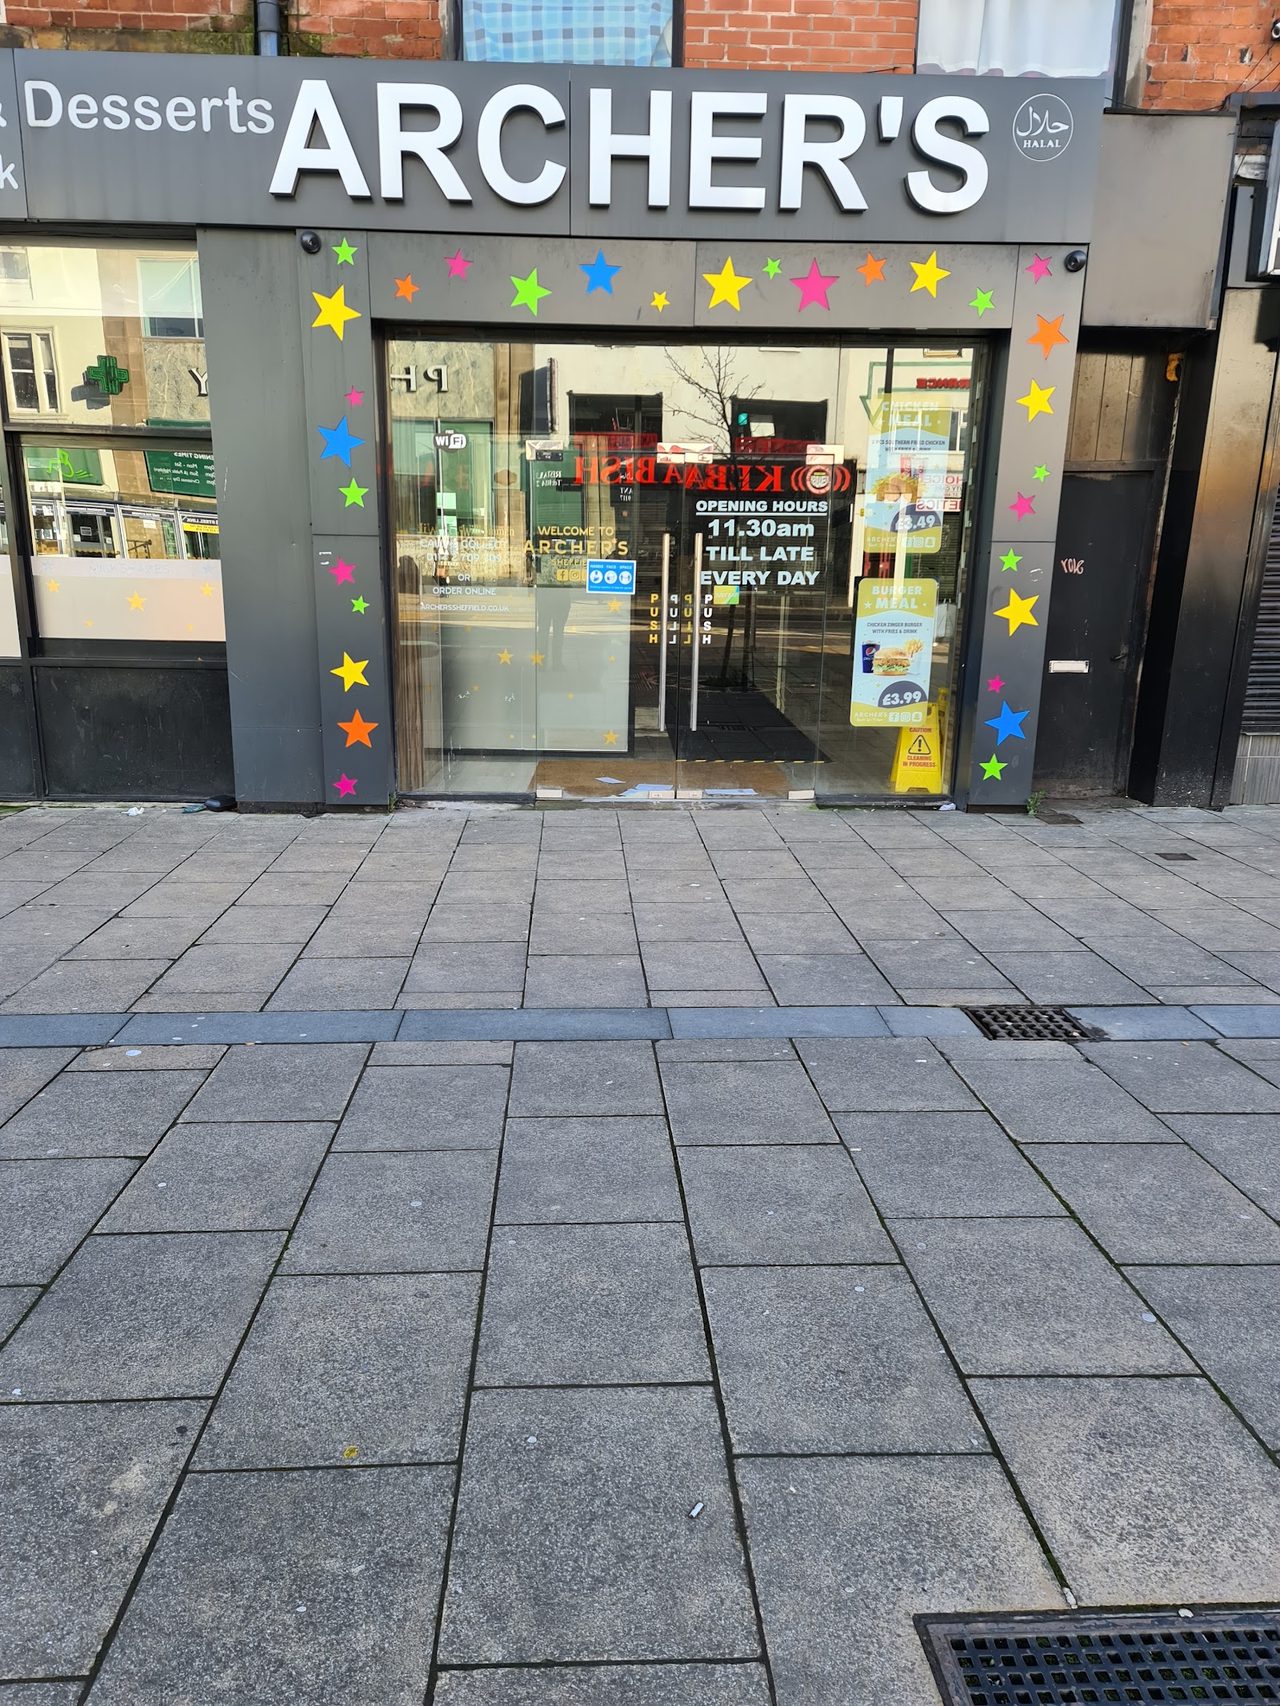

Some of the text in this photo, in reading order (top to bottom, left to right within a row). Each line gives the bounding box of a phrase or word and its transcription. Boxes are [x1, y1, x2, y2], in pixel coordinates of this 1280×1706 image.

[24, 80, 275, 134] Desserts
[1016, 106, 1070, 136] حلال
[268, 79, 990, 214] ARCHER'S
[1023, 138, 1062, 148] HALAL
[696, 500, 828, 512] OPENING HOURS
[708, 518, 815, 537] 11.30am
[895, 515, 935, 530] £3.49
[537, 526, 614, 536] WELCOME TO
[524, 539, 629, 555] ARCHER'S
[706, 546, 815, 561] TILL LATE
[457, 574, 471, 582] OR
[700, 571, 820, 585] EVERY DAY
[432, 587, 497, 596] ORDER ONLINE
[871, 586, 922, 596] BURGER
[875, 597, 918, 609] MEAL
[649, 593, 660, 644] PUSH
[702, 594, 713, 645] PUSH
[882, 691, 922, 707] £3.99
